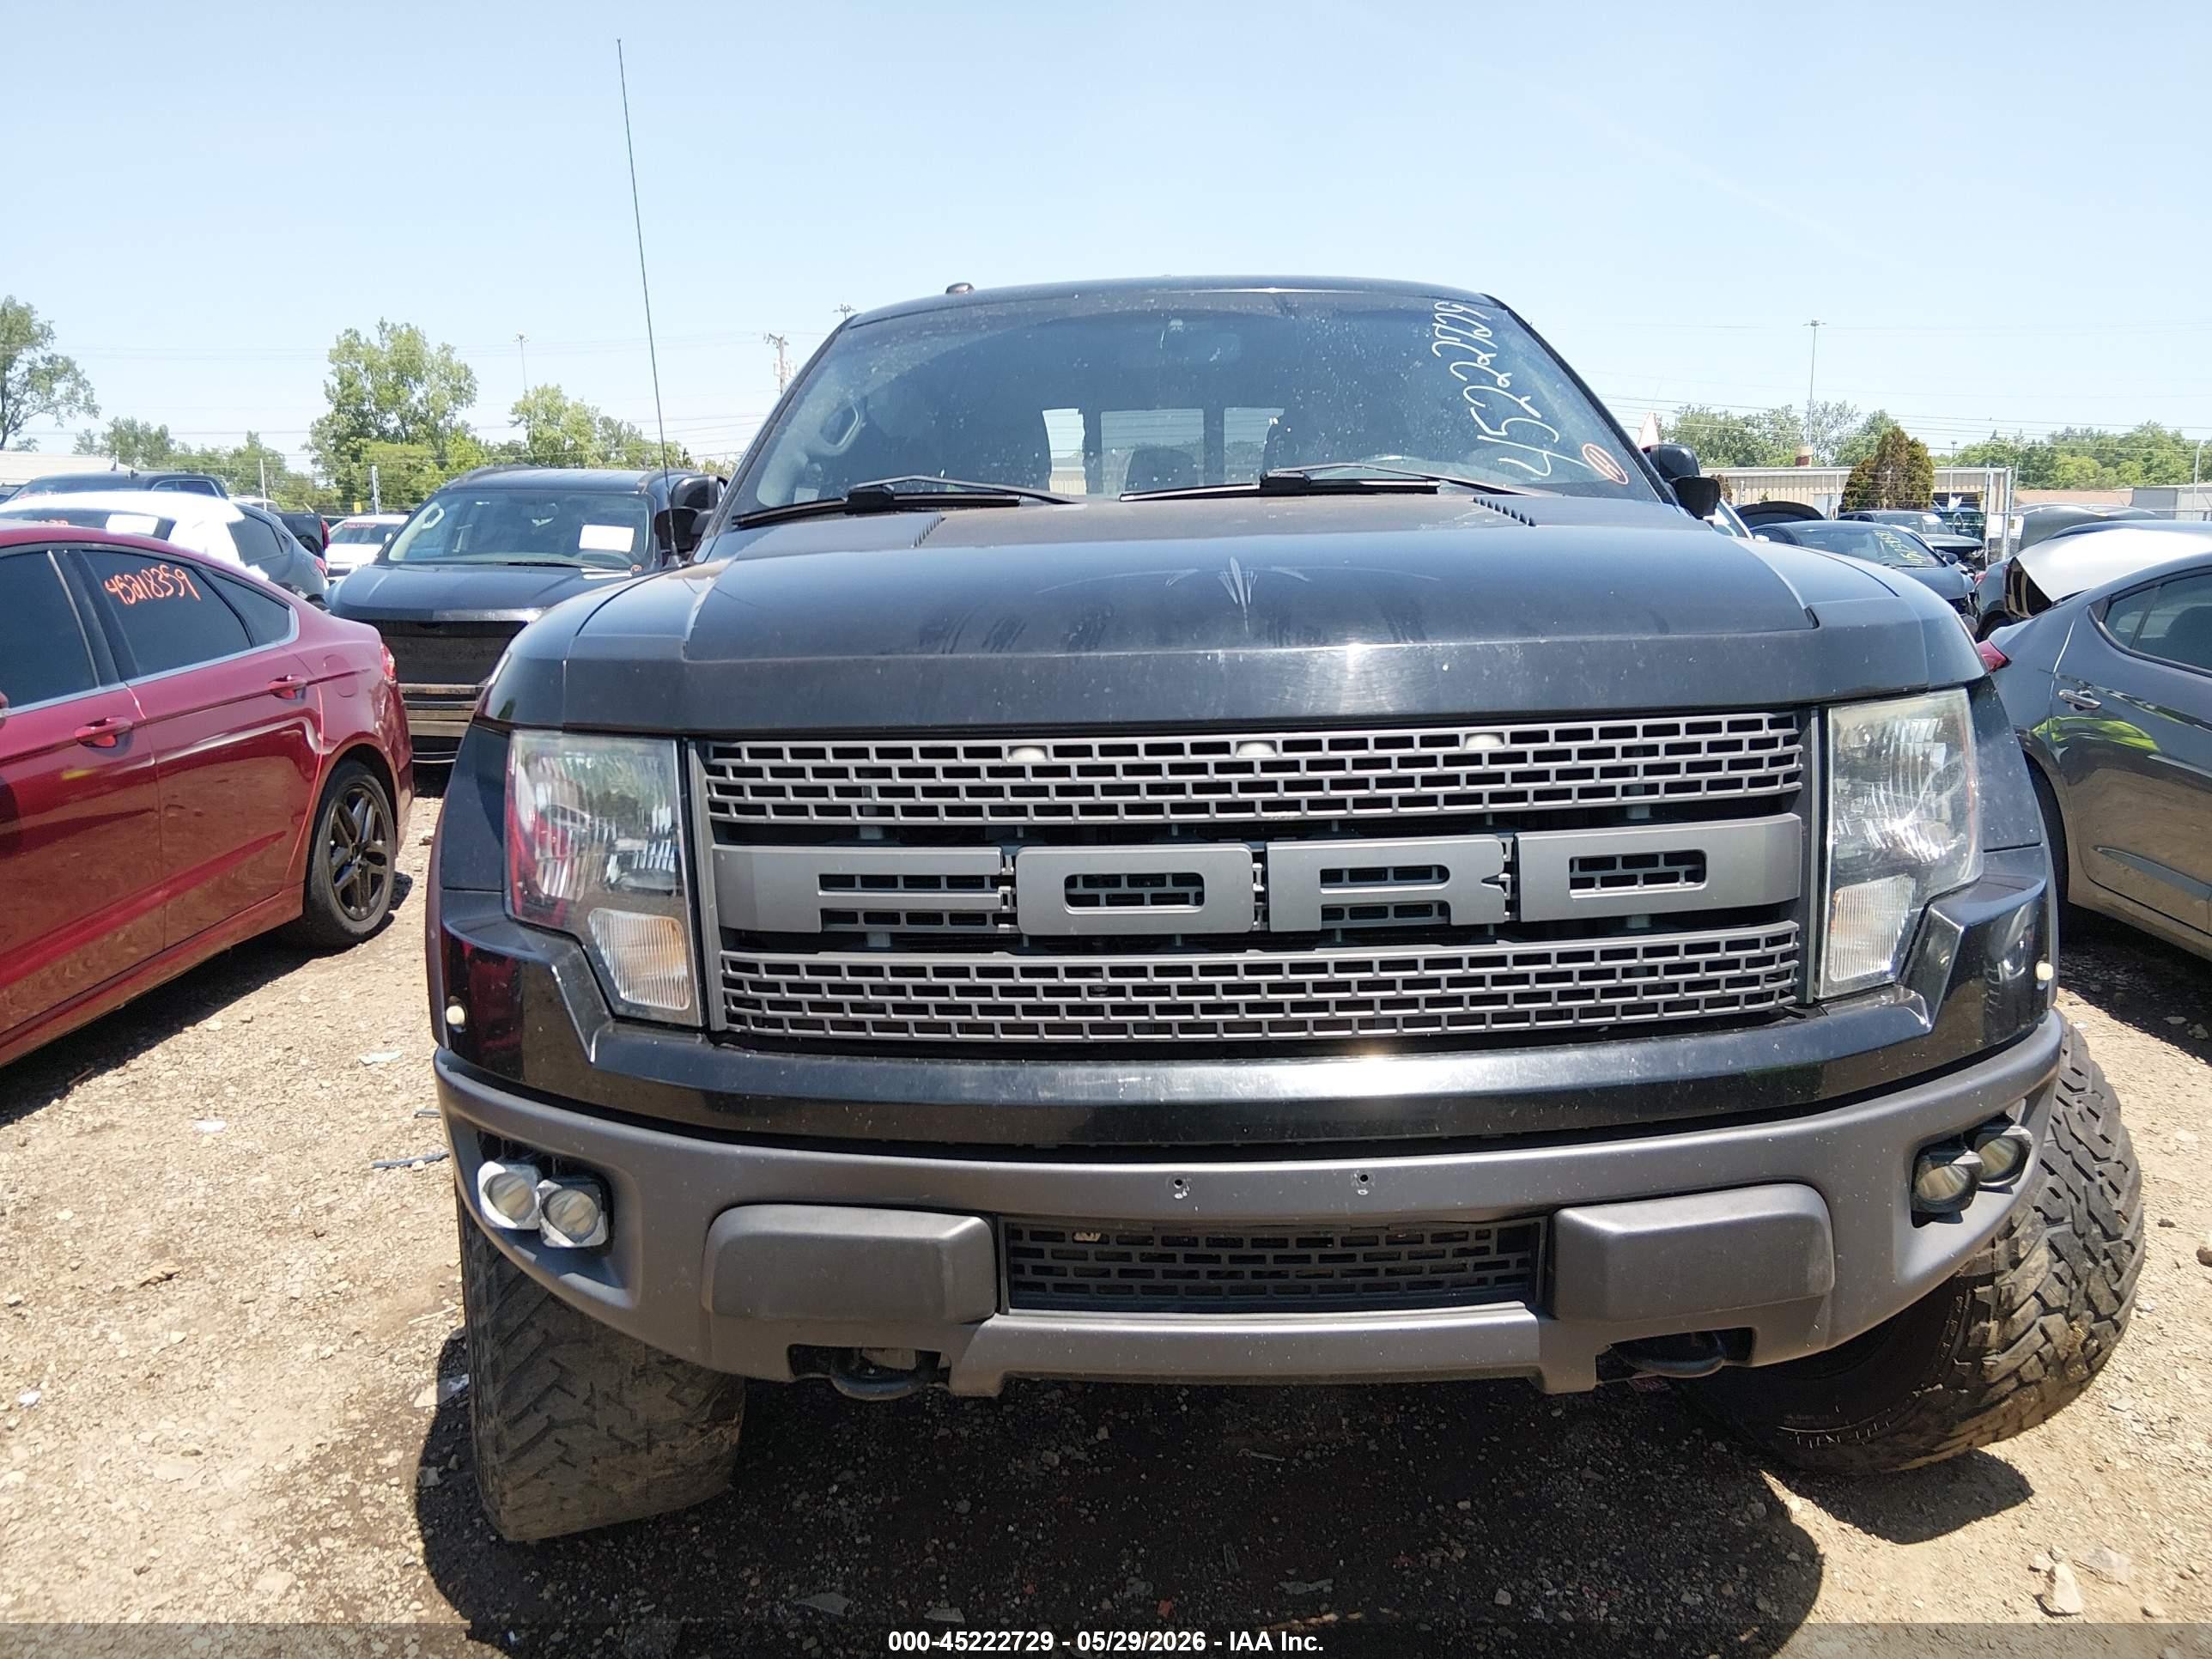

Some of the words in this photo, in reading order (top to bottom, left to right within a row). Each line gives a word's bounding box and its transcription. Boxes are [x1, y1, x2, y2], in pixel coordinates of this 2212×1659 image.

[1432, 301, 1589, 477] 45222729
[105, 564, 201, 605] 45218359
[713, 812, 1802, 937] FORD
